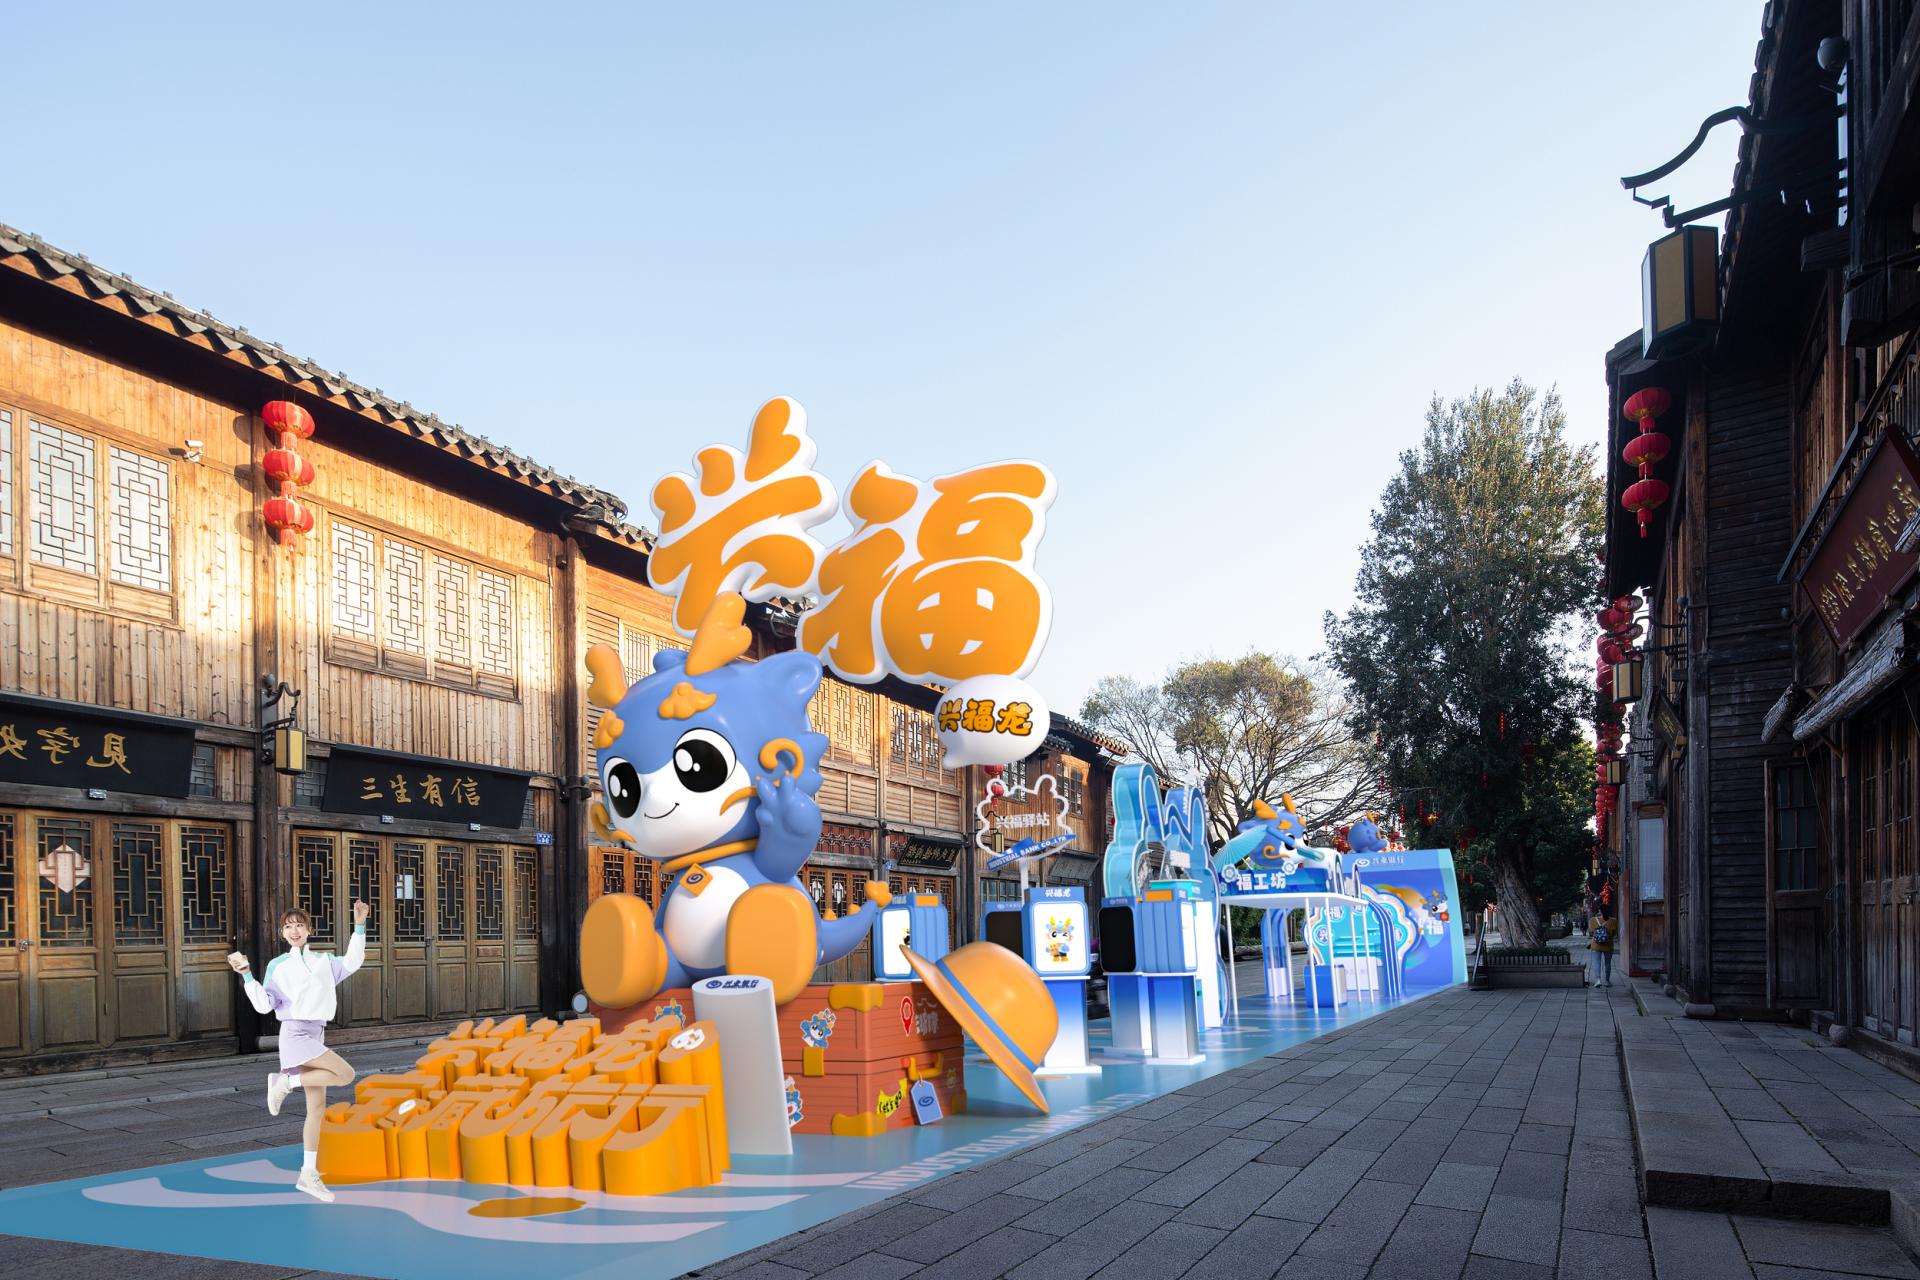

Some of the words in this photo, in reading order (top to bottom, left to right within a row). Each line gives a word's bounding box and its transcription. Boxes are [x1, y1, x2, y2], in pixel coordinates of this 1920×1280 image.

[938, 698, 1033, 736] 兴福龙
[360, 774, 481, 808] 三生有信
[996, 812, 1050, 829] 兴福驿站
[1020, 844, 1040, 856] BANK
[1237, 871, 1287, 891] 福工坊
[844, 1134, 1041, 1190] INDUSTRIAL
